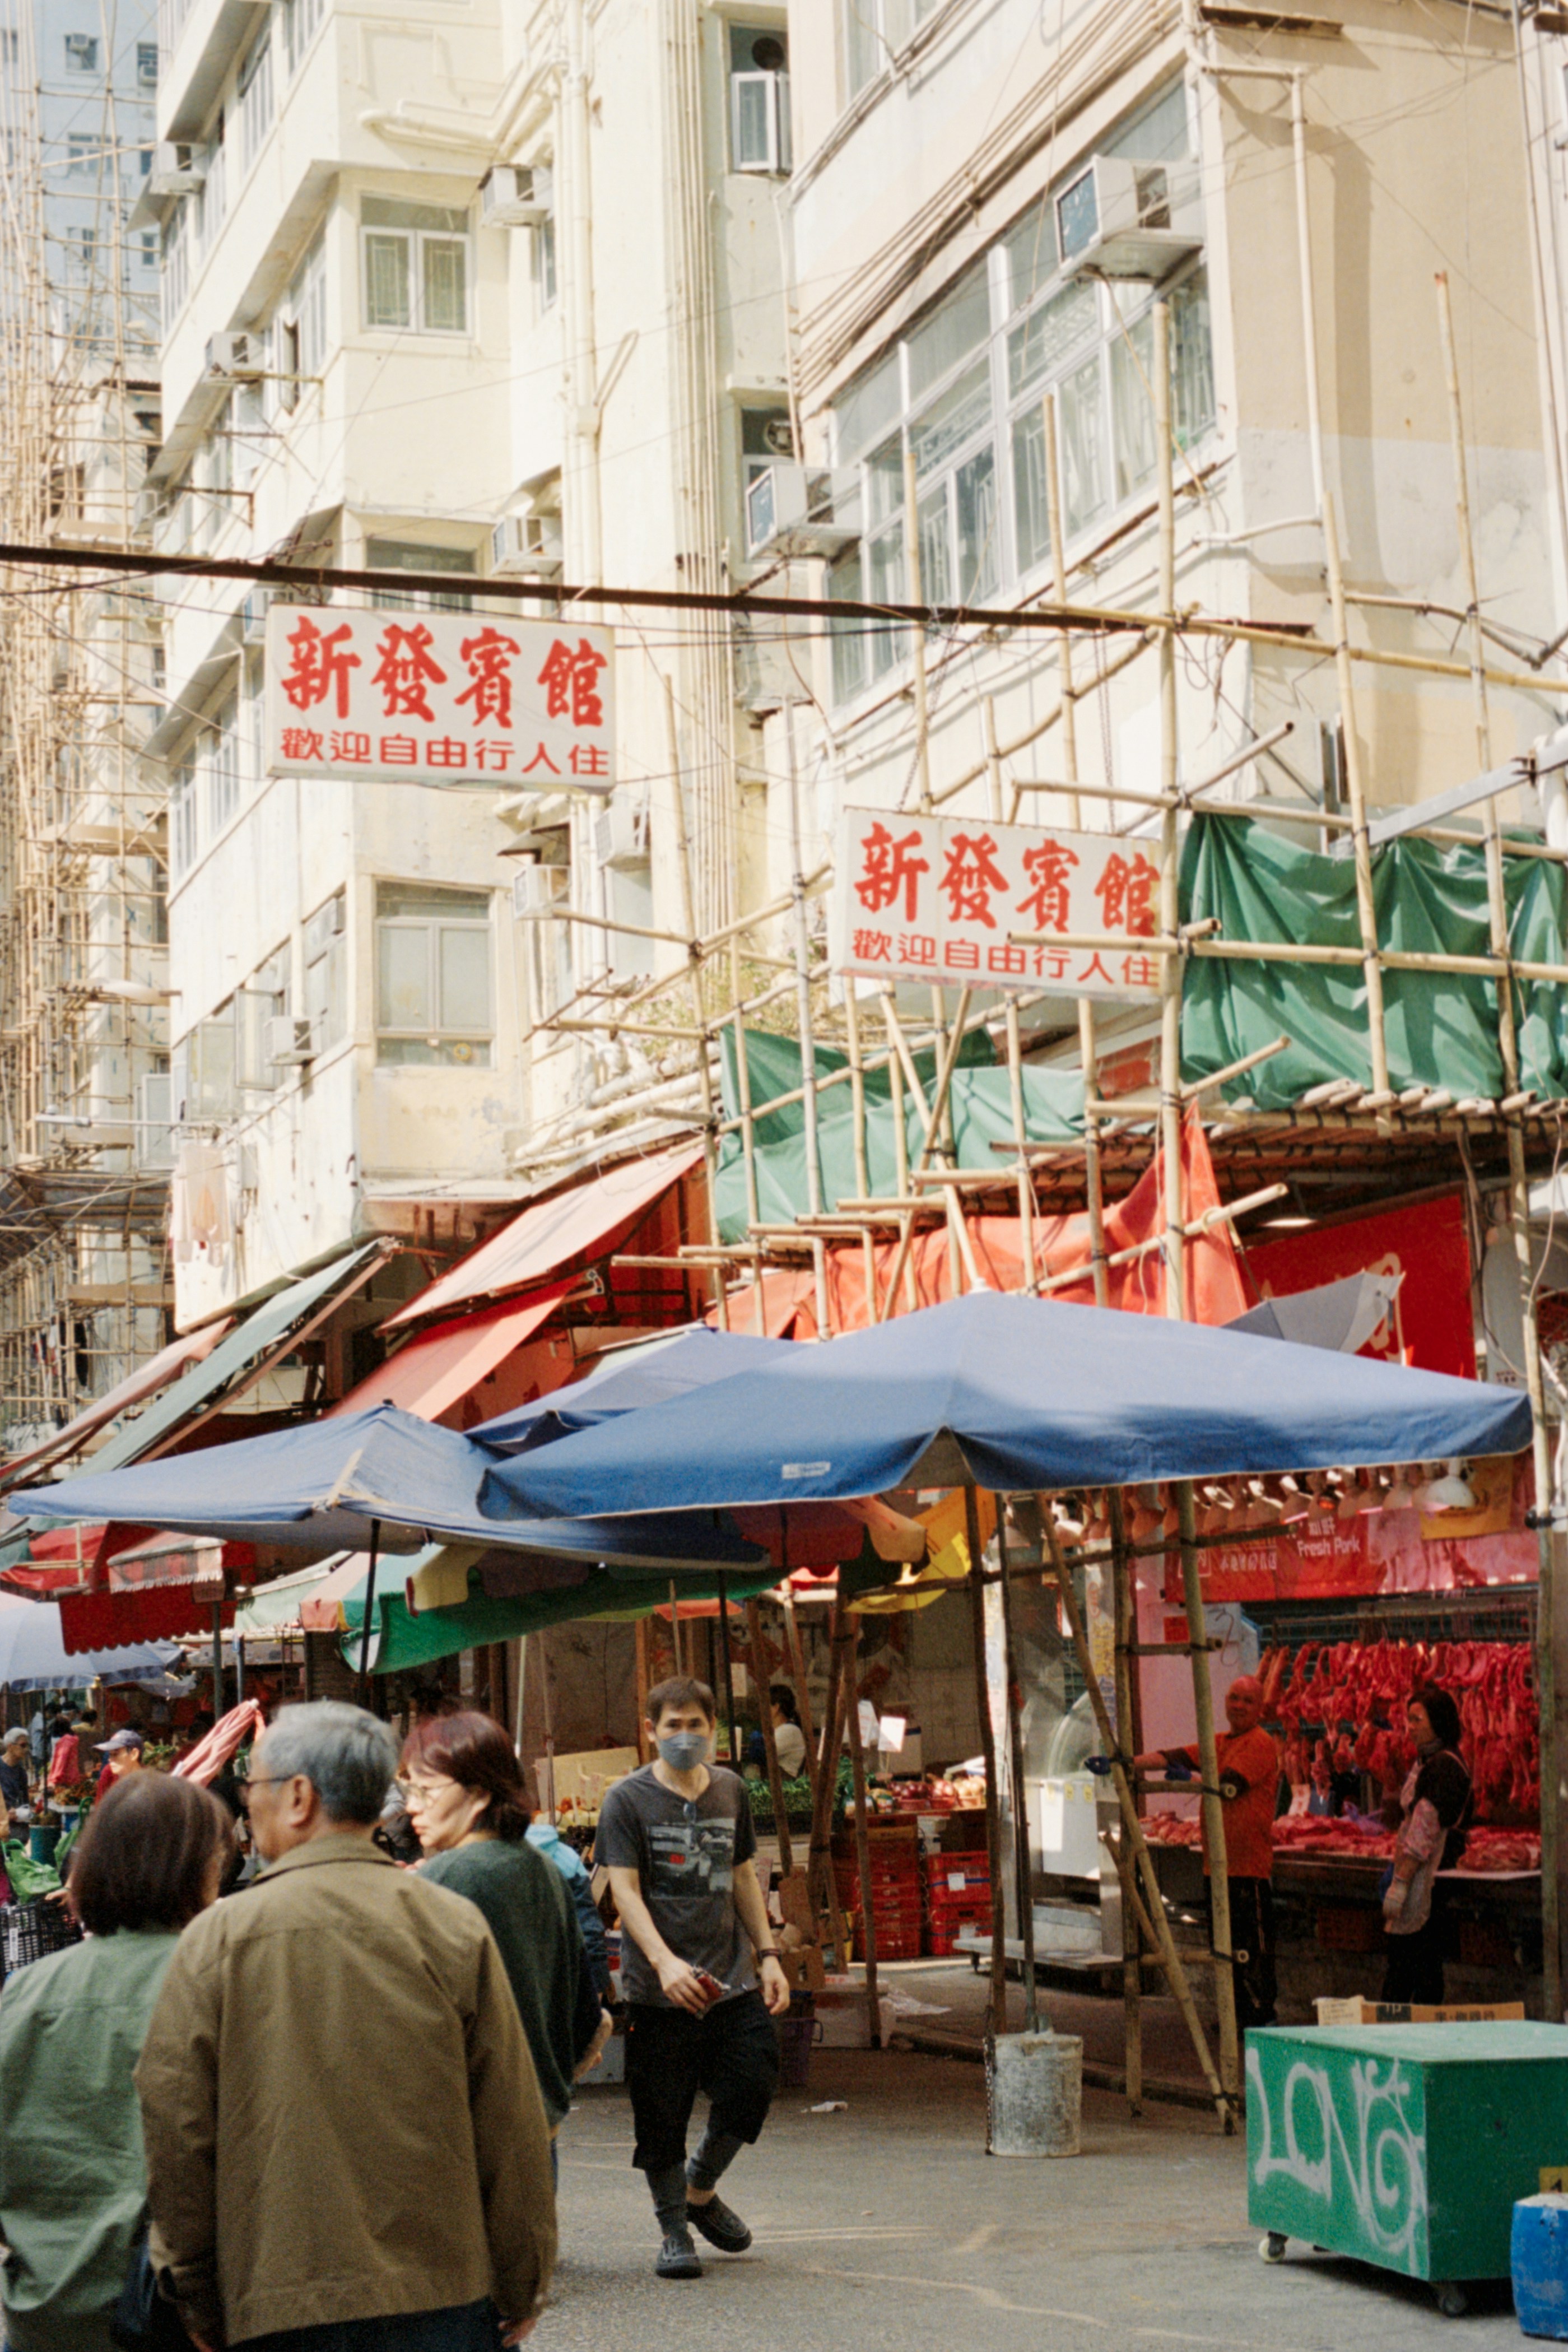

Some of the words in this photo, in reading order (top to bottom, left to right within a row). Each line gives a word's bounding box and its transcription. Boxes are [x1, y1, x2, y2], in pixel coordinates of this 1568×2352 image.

[281, 615, 607, 728] 新發賓館
[854, 821, 1160, 937] 新發賓館
[1297, 1538, 1332, 1557] Fresh
[1334, 1536, 1361, 1555] Pork
